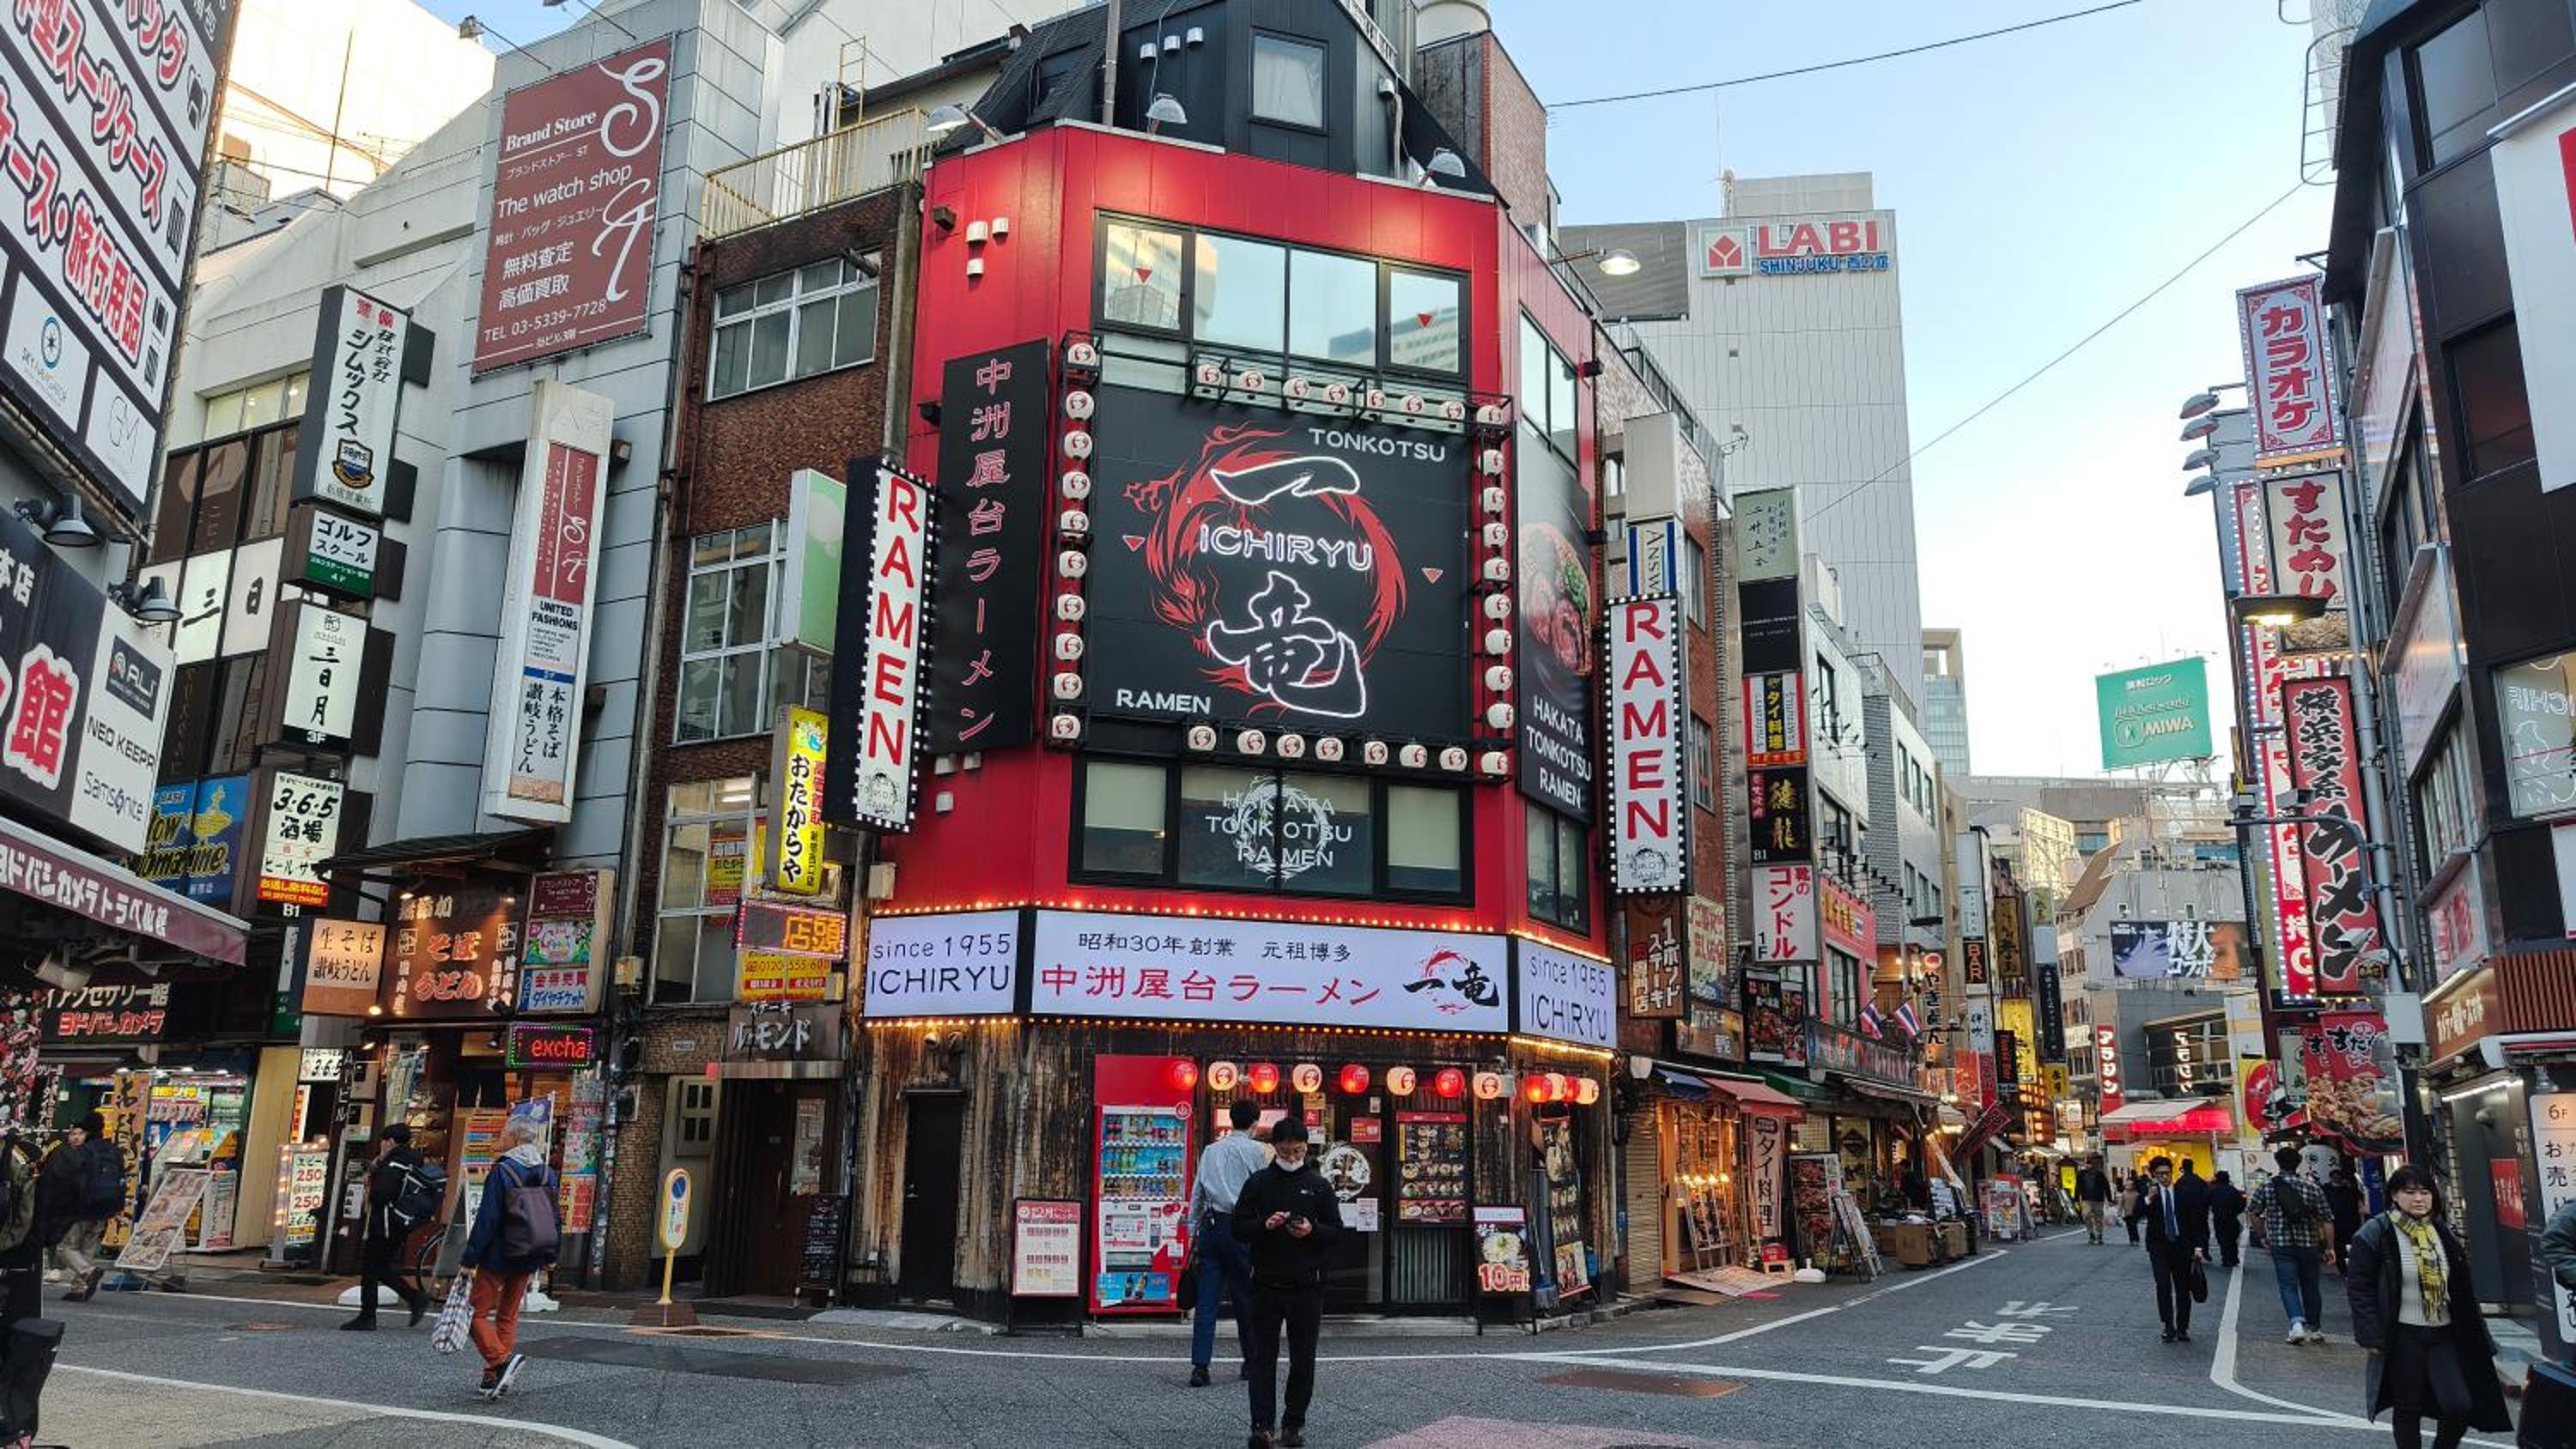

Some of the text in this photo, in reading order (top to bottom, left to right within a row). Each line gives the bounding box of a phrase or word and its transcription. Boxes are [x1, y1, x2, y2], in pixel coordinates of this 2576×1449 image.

[506, 111, 597, 152] Brand Store
[497, 164, 633, 218] The watch shop
[1758, 221, 1879, 256] LABI
[503, 242, 574, 277] 無料査定
[1759, 257, 1840, 274] SHINJUKU
[499, 276, 570, 311] 高価買取
[483, 300, 607, 343] TEL 03-5339-7728
[373, 330, 395, 384] 株式会社
[2261, 306, 2317, 432] カラオケ
[336, 329, 374, 436] シムックス
[1308, 427, 1447, 464] TONKOTSU
[317, 518, 372, 548] ゴルフ
[957, 358, 1012, 742] 中洲屋台ラーメン
[1200, 523, 1373, 572] ICHIRYU
[316, 539, 368, 564] スクール
[532, 613, 577, 631] FASHIONS
[540, 600, 574, 617] UNITED
[869, 476, 918, 766] RAMEN
[309, 646, 340, 727] 三日月
[1116, 688, 1211, 714] RAMEN
[87, 714, 114, 750] NEO
[307, 730, 325, 743] 3F
[519, 682, 543, 773] 讃岐うどん
[543, 687, 567, 759] 本格そば
[1533, 694, 1585, 744] HAKATA
[1622, 602, 1669, 840] RAMEN
[2145, 715, 2194, 737] MIWA
[1526, 724, 1592, 782] TONKOTSU
[83, 770, 145, 822] Samsonite
[1223, 789, 1336, 816] HAKATA
[1540, 771, 1582, 811] RAMEN
[280, 815, 323, 844] 酒場
[782, 753, 810, 883] おたからや
[1206, 815, 1353, 843] TONKOTSU
[2293, 687, 2375, 981] 横浜家系ラーメン
[1238, 846, 1334, 868] RAMEN
[283, 903, 301, 918] B1
[1769, 866, 1797, 961] コンドル
[320, 926, 377, 955] 生そば
[428, 931, 482, 962] そば
[782, 913, 841, 955] 店頭
[872, 932, 1012, 959] since 1955
[1078, 932, 1352, 962] 昭和30年創業 元祖博多
[314, 956, 372, 983] 讃岐うどん
[534, 971, 588, 987] 金券売買
[870, 964, 1011, 996] ICHIRYU
[1529, 953, 1607, 997] since 1955
[1647, 933, 1664, 1009] ステーキ
[1662, 917, 1680, 1009] 1ポンド
[1969, 943, 1984, 985] BAR
[415, 971, 483, 1002] うどん
[532, 990, 585, 1008] ダイヤチケット
[1042, 962, 1380, 1007] 中洲屋台ラーメン
[1402, 961, 1499, 1007] 一竜
[59, 1010, 166, 1036] ヨドバシカメラ
[750, 1000, 793, 1016] ステーキ
[1529, 993, 1608, 1041] ICHIRYU
[531, 1034, 588, 1060] excha
[732, 1019, 811, 1052] ルモンド
[2548, 1106, 2568, 1121] 6F
[296, 1168, 322, 1182] 250
[1757, 1136, 1781, 1229] タイ料理
[295, 1196, 321, 1209] 250
